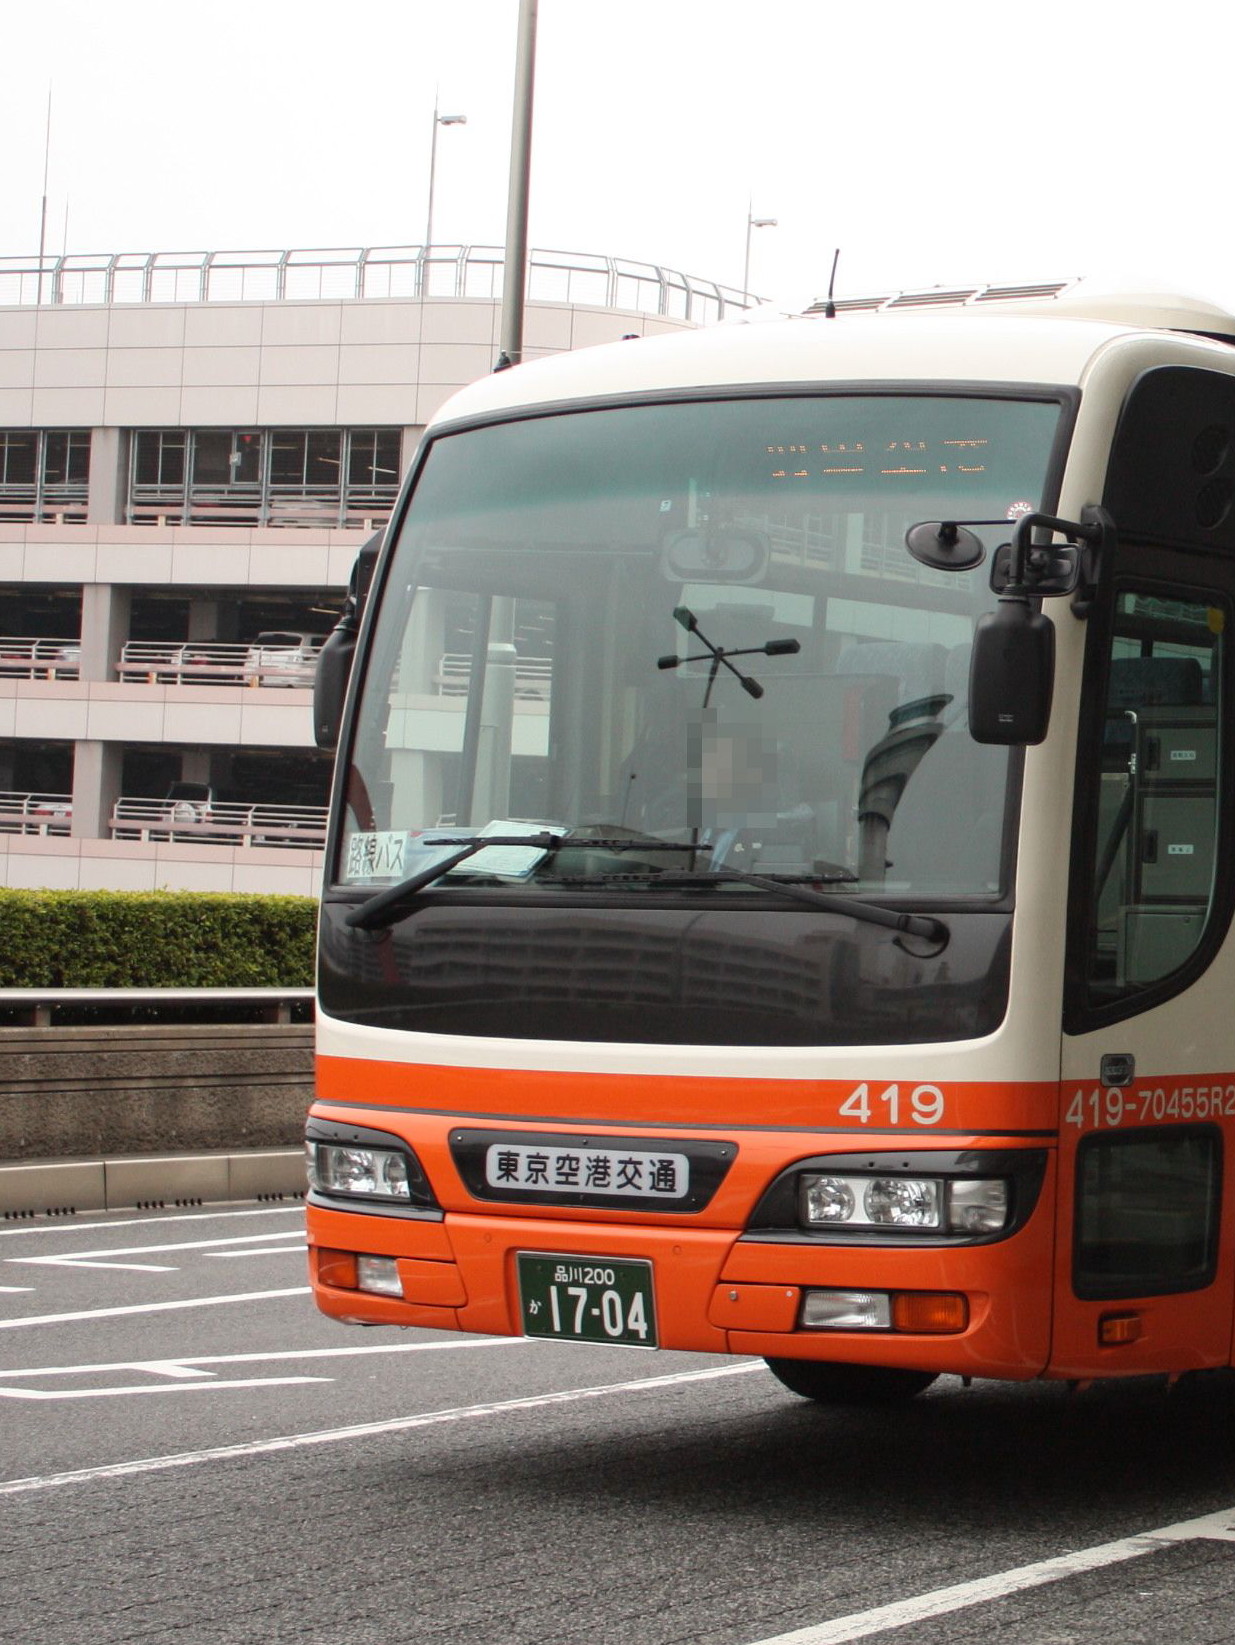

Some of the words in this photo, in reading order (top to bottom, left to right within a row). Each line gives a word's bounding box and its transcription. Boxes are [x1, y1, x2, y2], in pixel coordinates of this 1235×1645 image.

[348, 834, 404, 876] 路線バス
[839, 1083, 944, 1125] 419
[496, 1150, 677, 1193] 東京空港交通
[554, 1265, 615, 1285] 品川200
[529, 1299, 542, 1315] か
[550, 1285, 648, 1339] 17-04
